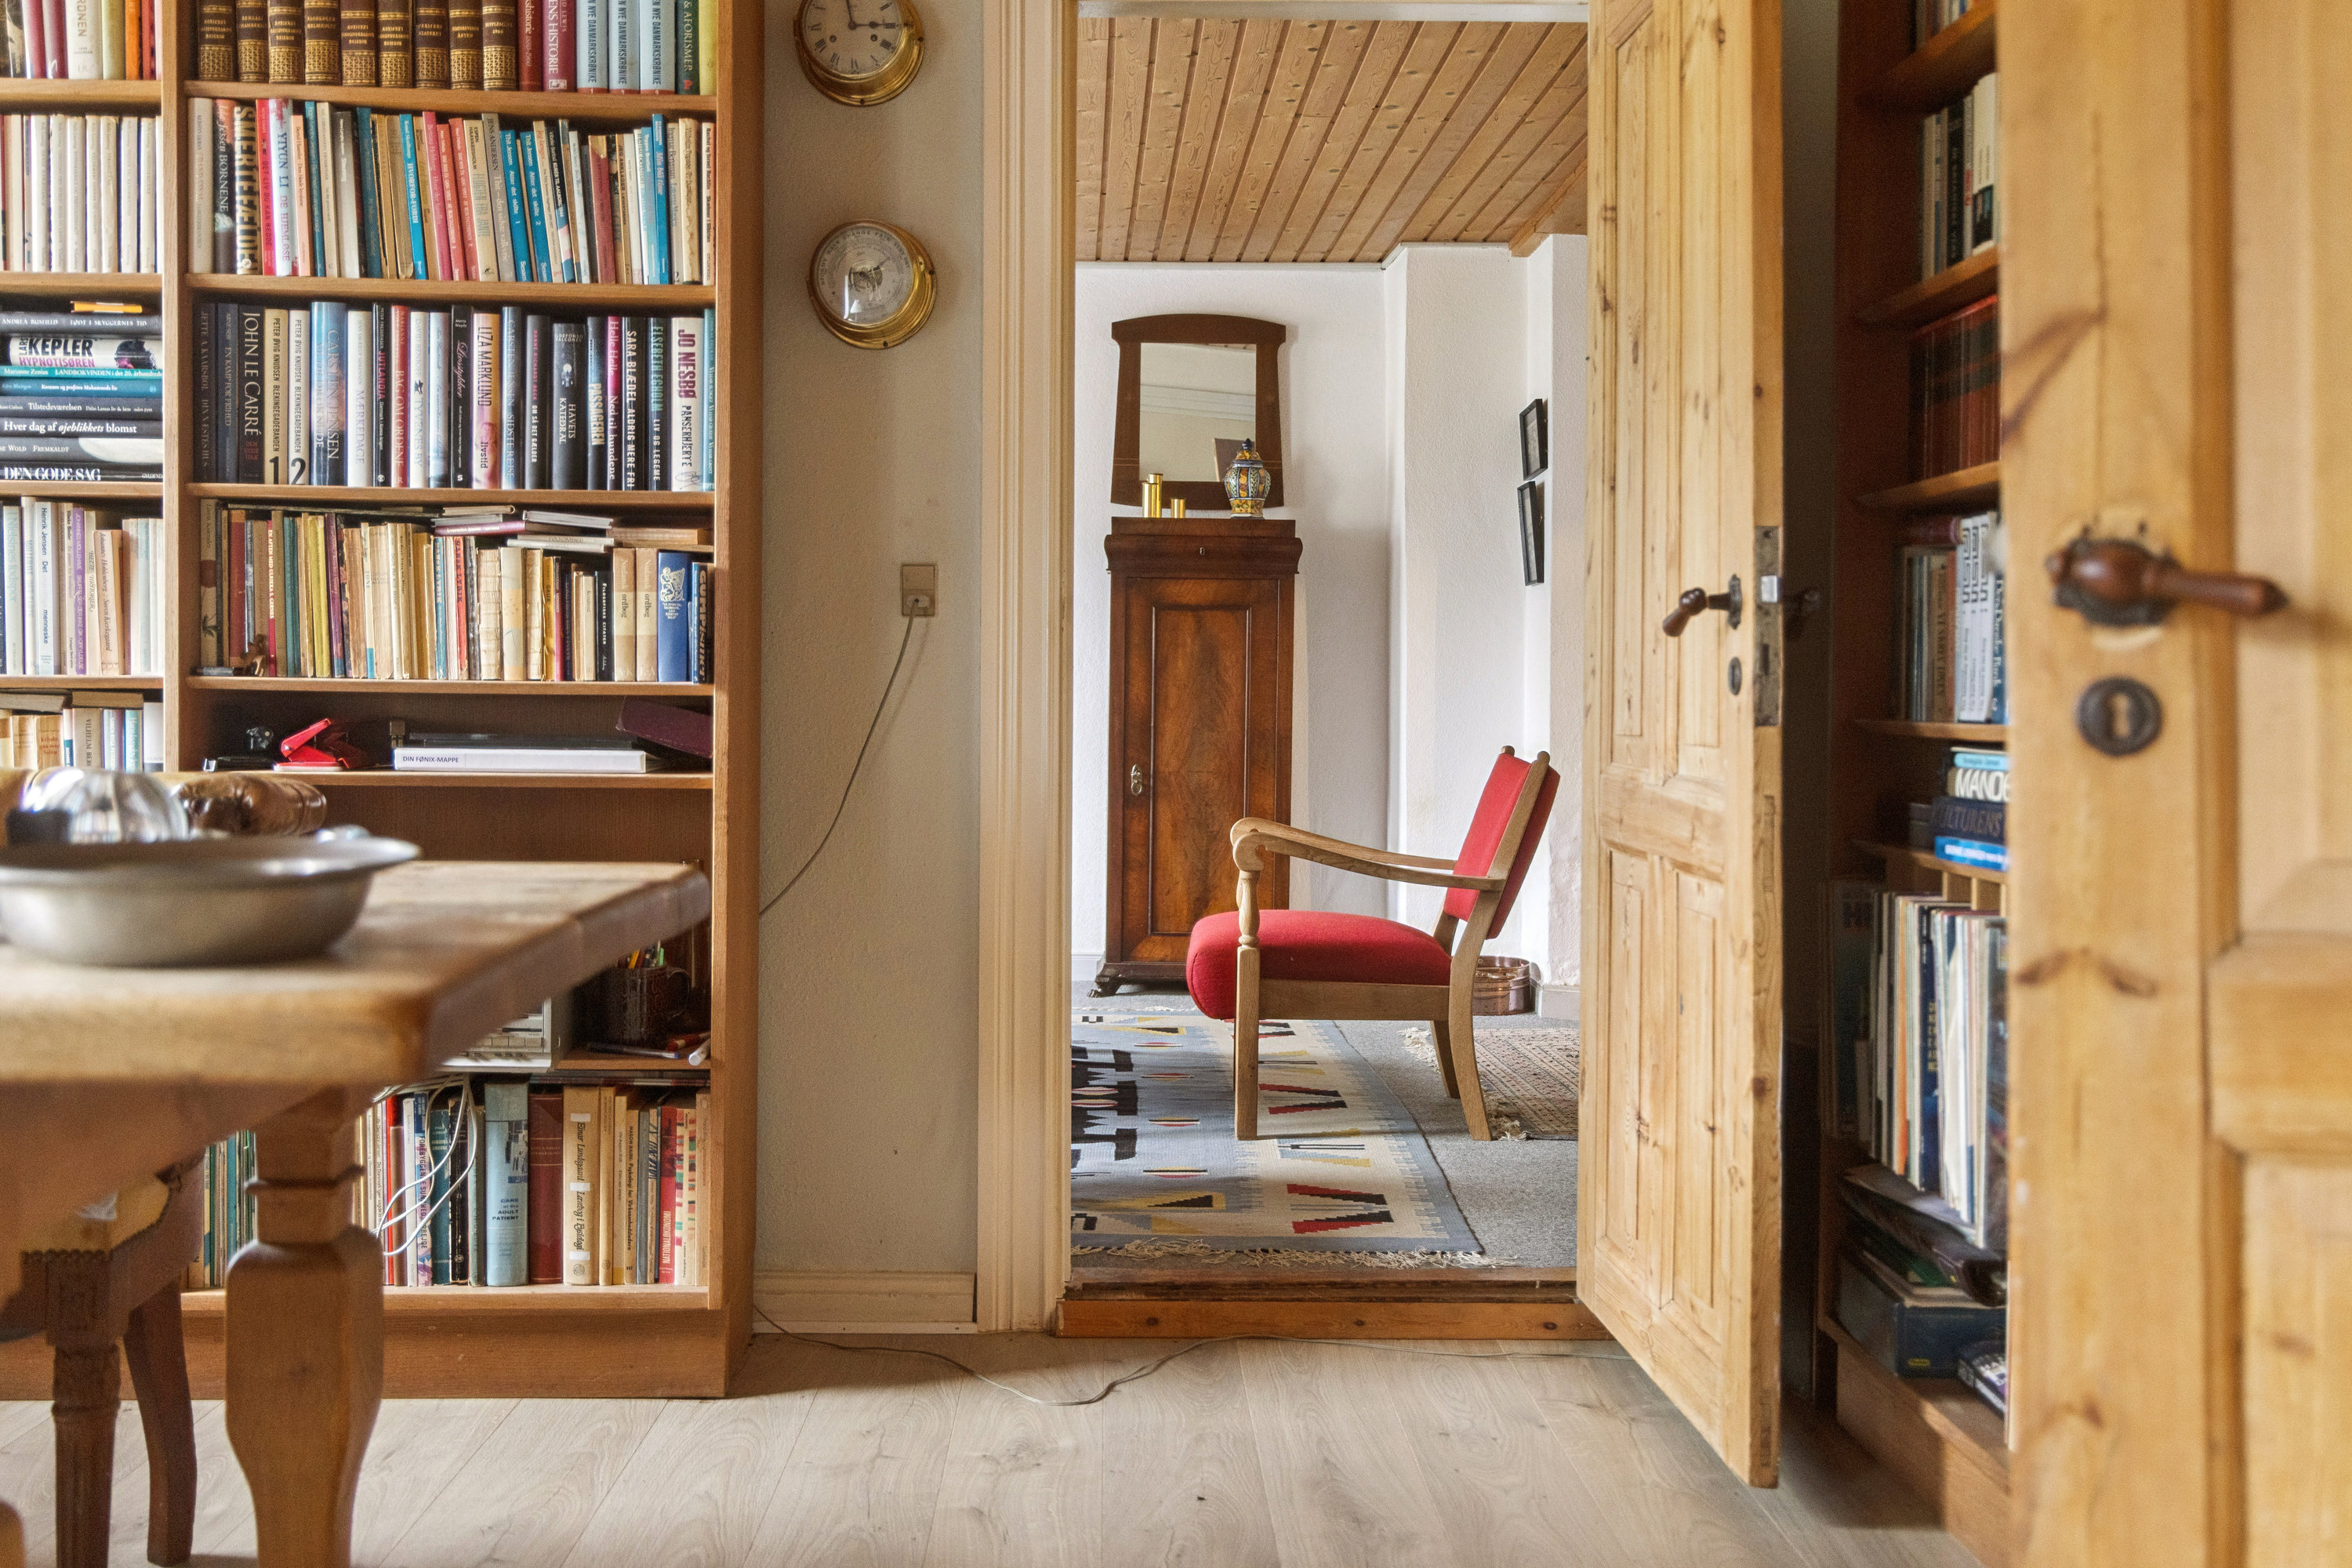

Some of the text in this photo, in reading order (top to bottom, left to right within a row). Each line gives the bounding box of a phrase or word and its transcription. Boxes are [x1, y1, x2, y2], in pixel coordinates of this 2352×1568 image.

[548, 23, 559, 74] HISTORIE
[587, 6, 596, 83] NYE DANMARKSKRØNIKE
[618, 7, 627, 85] NYE DANMARKSKRØNIKE
[652, 8, 661, 85] NYE DANMARKSKRØNIKE
[683, 11, 694, 71] AFORISMER
[485, 118, 495, 133] JENS
[488, 133, 499, 171] ANDERSEN
[234, 107, 259, 274] SMERTEFÆLDEN
[277, 132, 291, 261] YIYUN LI DE HJEMLØSE
[407, 162, 419, 223] HVORFOR-FORDI
[18, 336, 29, 356] LARS
[19, 357, 96, 368] HYPNOTISØREN
[28, 338, 93, 358] KEPLER
[225, 347, 232, 358] EN
[272, 338, 281, 353] ØVIG
[294, 339, 303, 354] ØVIG
[242, 312, 262, 436] JOHN LE CARRÉ
[395, 370, 405, 392] BAG
[224, 398, 233, 426] FRIHED
[326, 328, 339, 459] CARSTEN JENSEN
[395, 396, 405, 416] OM
[477, 326, 493, 469] LIZA MARKLUND livstid
[506, 319, 515, 478] CARSTEN JENSEN SIDSTE REJSE
[608, 321, 619, 481] Helle Helle Ned til hundene
[626, 330, 637, 487] SARA BLÆDEL ALDRIG MERE FRI
[677, 328, 697, 466] JO NESBØ PANSERHJERTE
[4, 421, 137, 434] Hver dag af øjeblikkets blomst
[588, 383, 605, 445] PASSAGEREN
[394, 419, 405, 466] ORDENE
[653, 435, 660, 446] OG
[4, 466, 101, 481] DEN GODE SAG
[269, 455, 280, 485] 1
[290, 457, 307, 485] 2
[576, 1122, 586, 1141] Einar
[575, 1143, 586, 1181] Lundsgaard
[574, 1222, 585, 1250] Fysiologi
[662, 1210, 672, 1264] NATIONALØKONOMI
